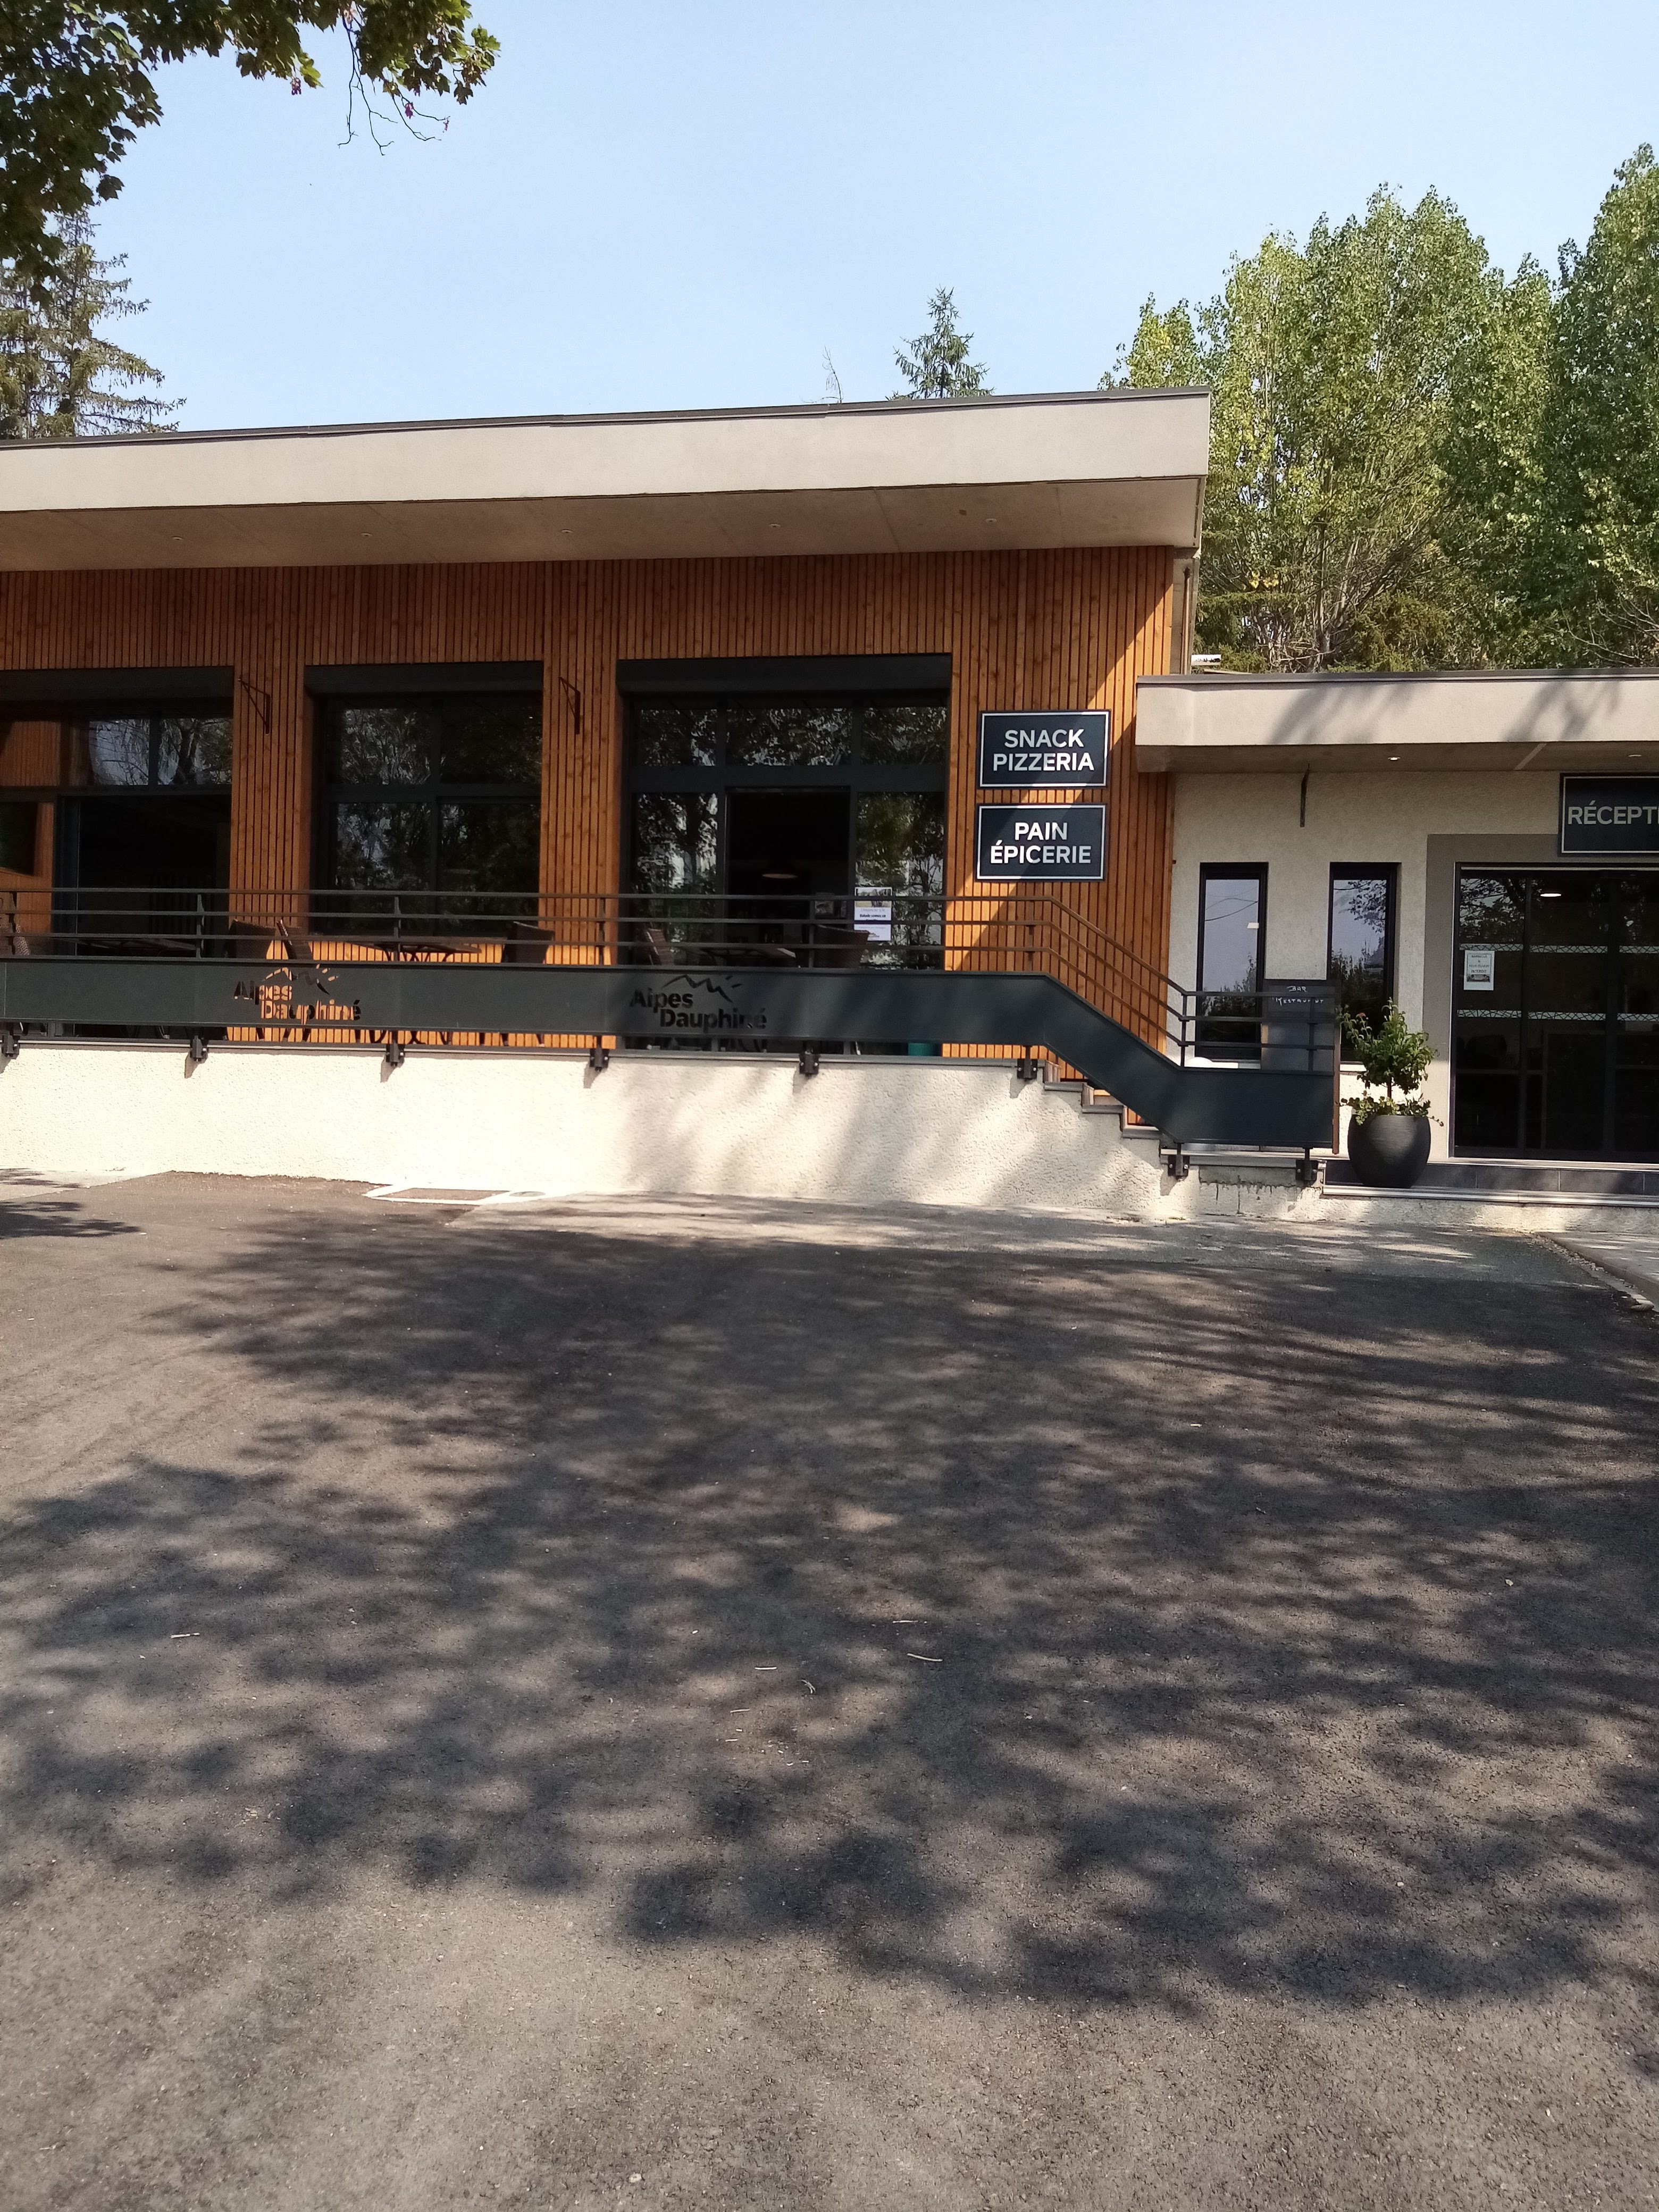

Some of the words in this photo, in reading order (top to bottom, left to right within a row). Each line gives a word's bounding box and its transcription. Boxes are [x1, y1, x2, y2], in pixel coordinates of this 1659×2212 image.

[1004, 729, 1084, 748] SNACK
[993, 752, 1094, 771] PIZZERIA
[1568, 800, 1659, 824] RÉCEPT
[1015, 822, 1067, 840] PAIN
[990, 840, 1092, 864] ÉPICERIE
[233, 981, 292, 1005] Alpes
[261, 1000, 362, 1025] Dauphiné
[660, 1008, 767, 1033] Dauphiné
